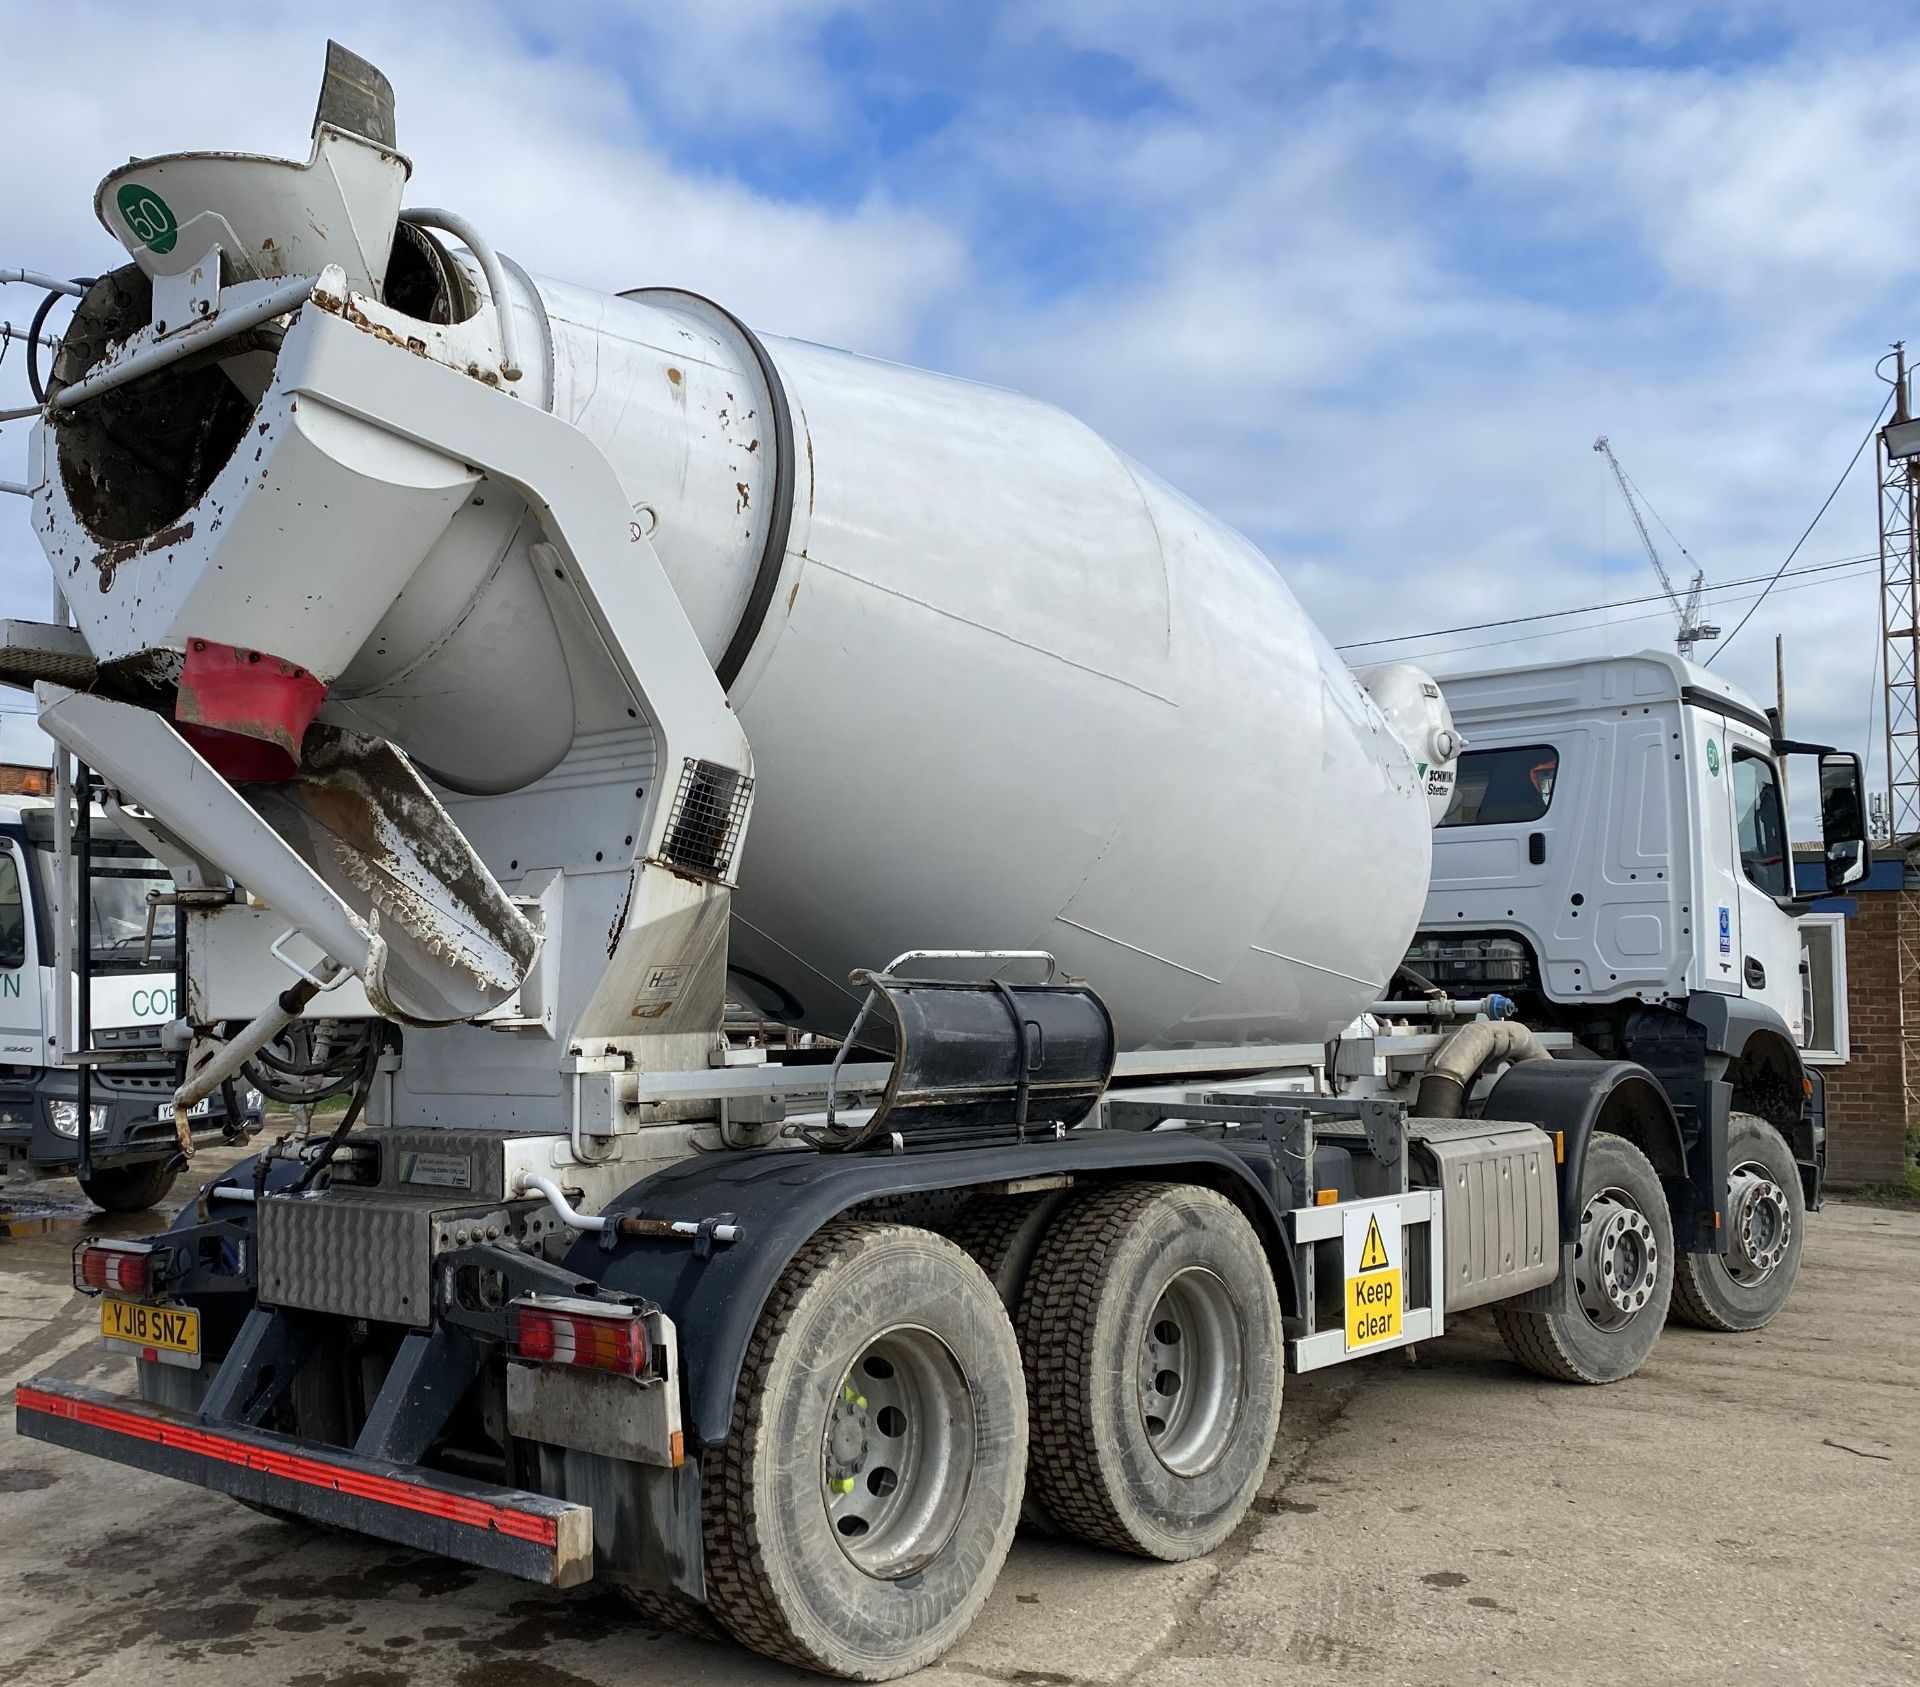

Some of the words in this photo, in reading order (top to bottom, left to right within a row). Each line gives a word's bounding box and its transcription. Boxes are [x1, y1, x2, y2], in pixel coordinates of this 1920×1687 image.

[126, 198, 168, 240] 50
[1427, 783, 1449, 796] Stetter
[0, 973, 20, 998] N
[1355, 1280, 1393, 1307] Keep
[113, 1303, 147, 1337] YJ18
[151, 1311, 187, 1345] SNZ
[1356, 1312, 1393, 1340] clear
